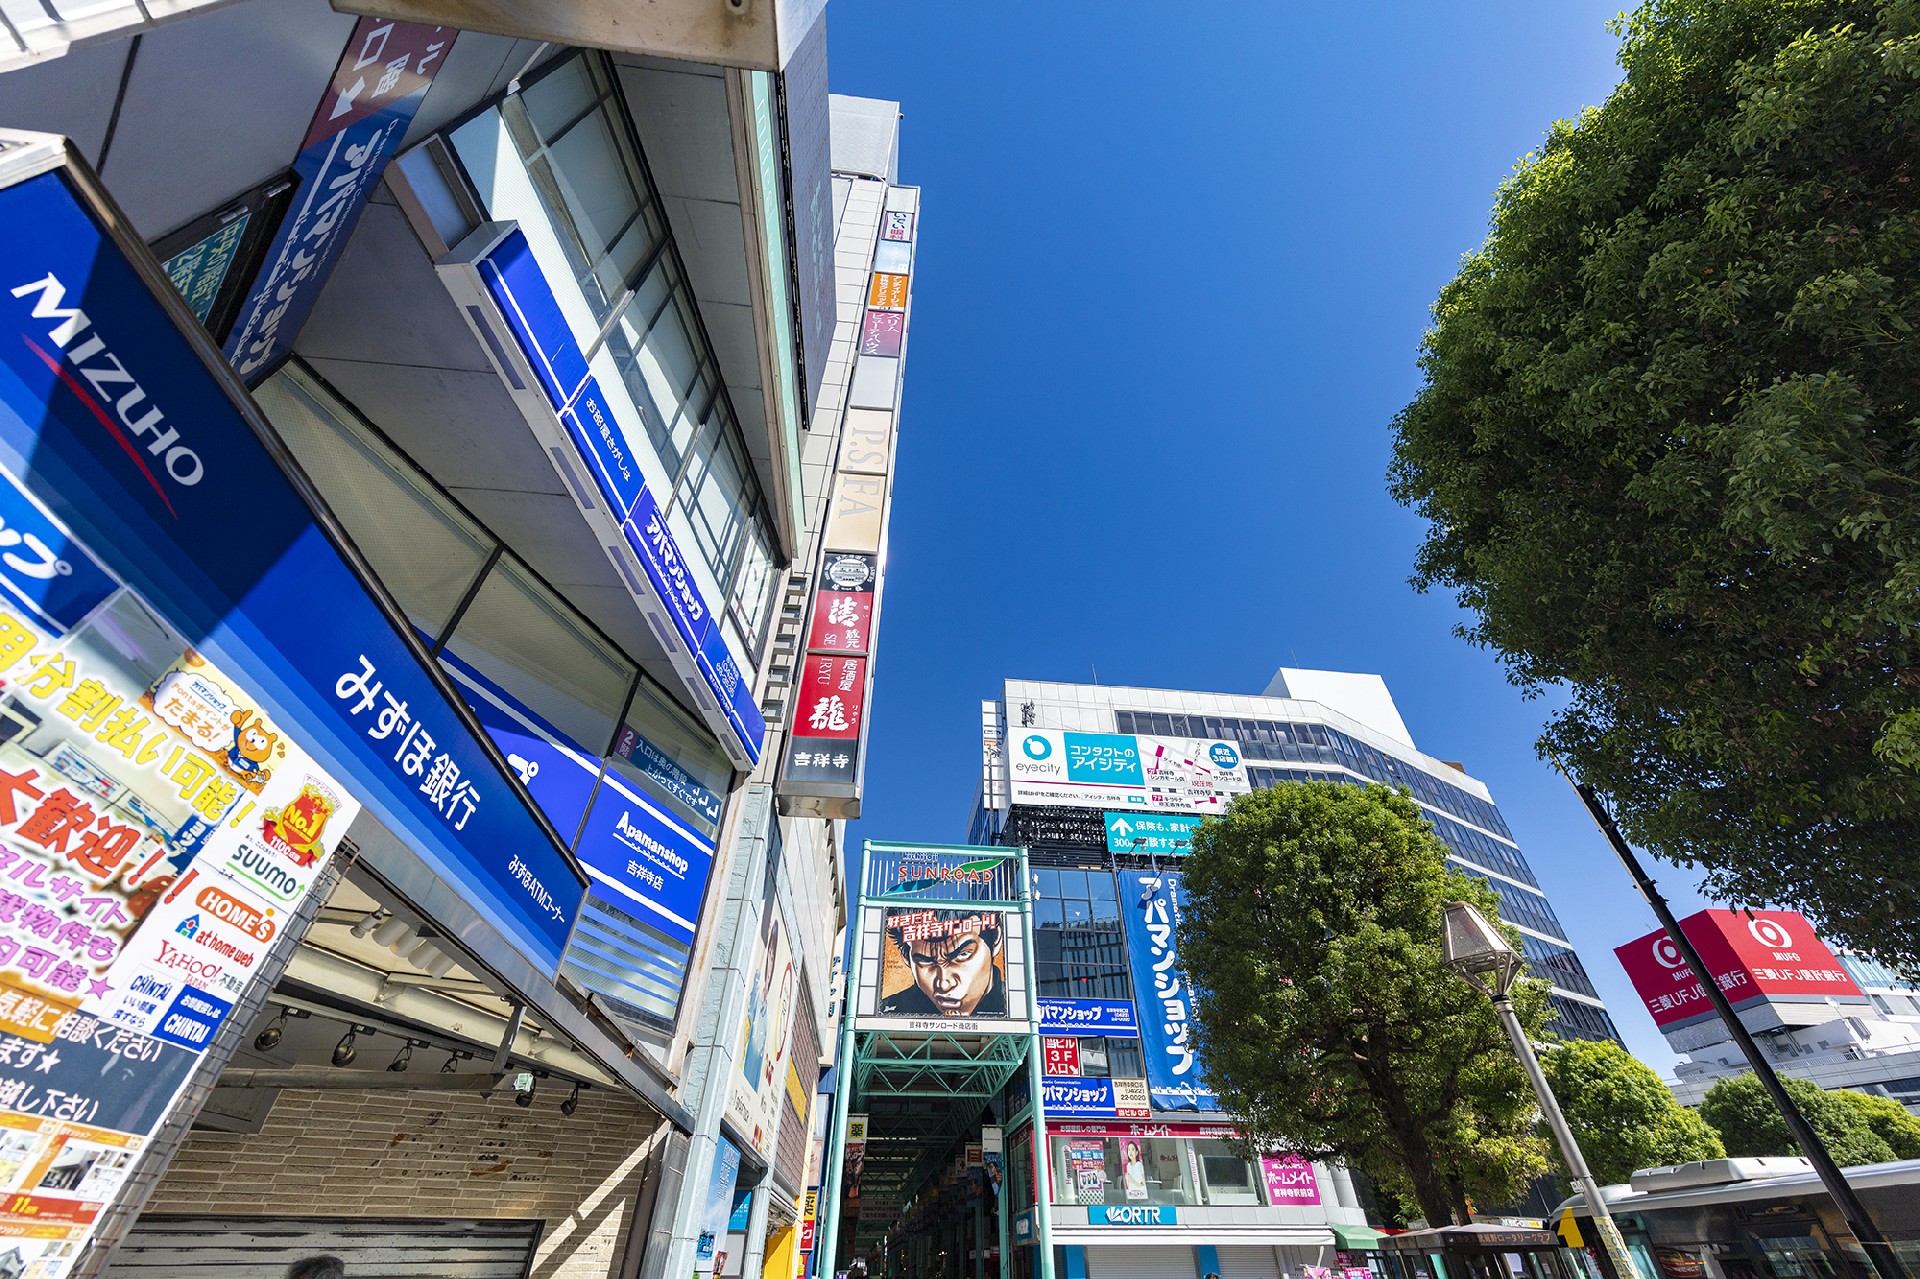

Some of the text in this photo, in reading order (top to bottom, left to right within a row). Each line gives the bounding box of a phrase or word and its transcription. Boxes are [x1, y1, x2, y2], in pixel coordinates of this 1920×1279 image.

[240, 128, 382, 375] アパマンショップ
[10, 271, 204, 486] MIZUHO
[586, 397, 632, 482] お部屋さがしは
[645, 513, 703, 621] アパマンショップ
[839, 660, 858, 691] 居酒屋
[163, 697, 222, 744] たまる!
[171, 681, 231, 731] Pontaポイントが
[808, 695, 849, 731] 龍
[336, 654, 480, 830] みずほ銀行
[1070, 745, 1135, 758] コンタクトの
[635, 739, 687, 783] 入口は奥の階段
[794, 752, 849, 768] 吉祥寺
[1016, 762, 1060, 775] eyecity
[1072, 757, 1137, 773] アイシティ
[645, 764, 698, 807] 上がってすぐです
[283, 802, 321, 838] No.1
[1135, 820, 1195, 833] 保険も、家計
[615, 811, 688, 873] Apamanshop
[509, 854, 565, 923] みずほATMコーナー
[626, 860, 663, 891] 吉祥寺店
[899, 866, 994, 882] SUNROAD
[200, 890, 273, 942] HOME'S
[154, 940, 223, 980] YAHOO!
[1772, 953, 1801, 962] MUFG
[131, 974, 172, 1002] CHINTAI
[185, 974, 208, 990] JAPAN
[219, 970, 244, 994] 不動産
[1138, 877, 1194, 1075] アパマンショップ
[1752, 967, 1848, 983] 三菱UFJ信託銀行
[164, 1013, 210, 1044] CHINTAI
[909, 1021, 979, 1031] 吉祥寺サンロード商店街
[1046, 1039, 1075, 1049] 当ビル
[1048, 1062, 1069, 1074] 入口
[1130, 1124, 1172, 1136] ホームメイト
[1267, 1172, 1314, 1184] ホームメイト
[1273, 1188, 1314, 1197] 吉祥寺駅前店
